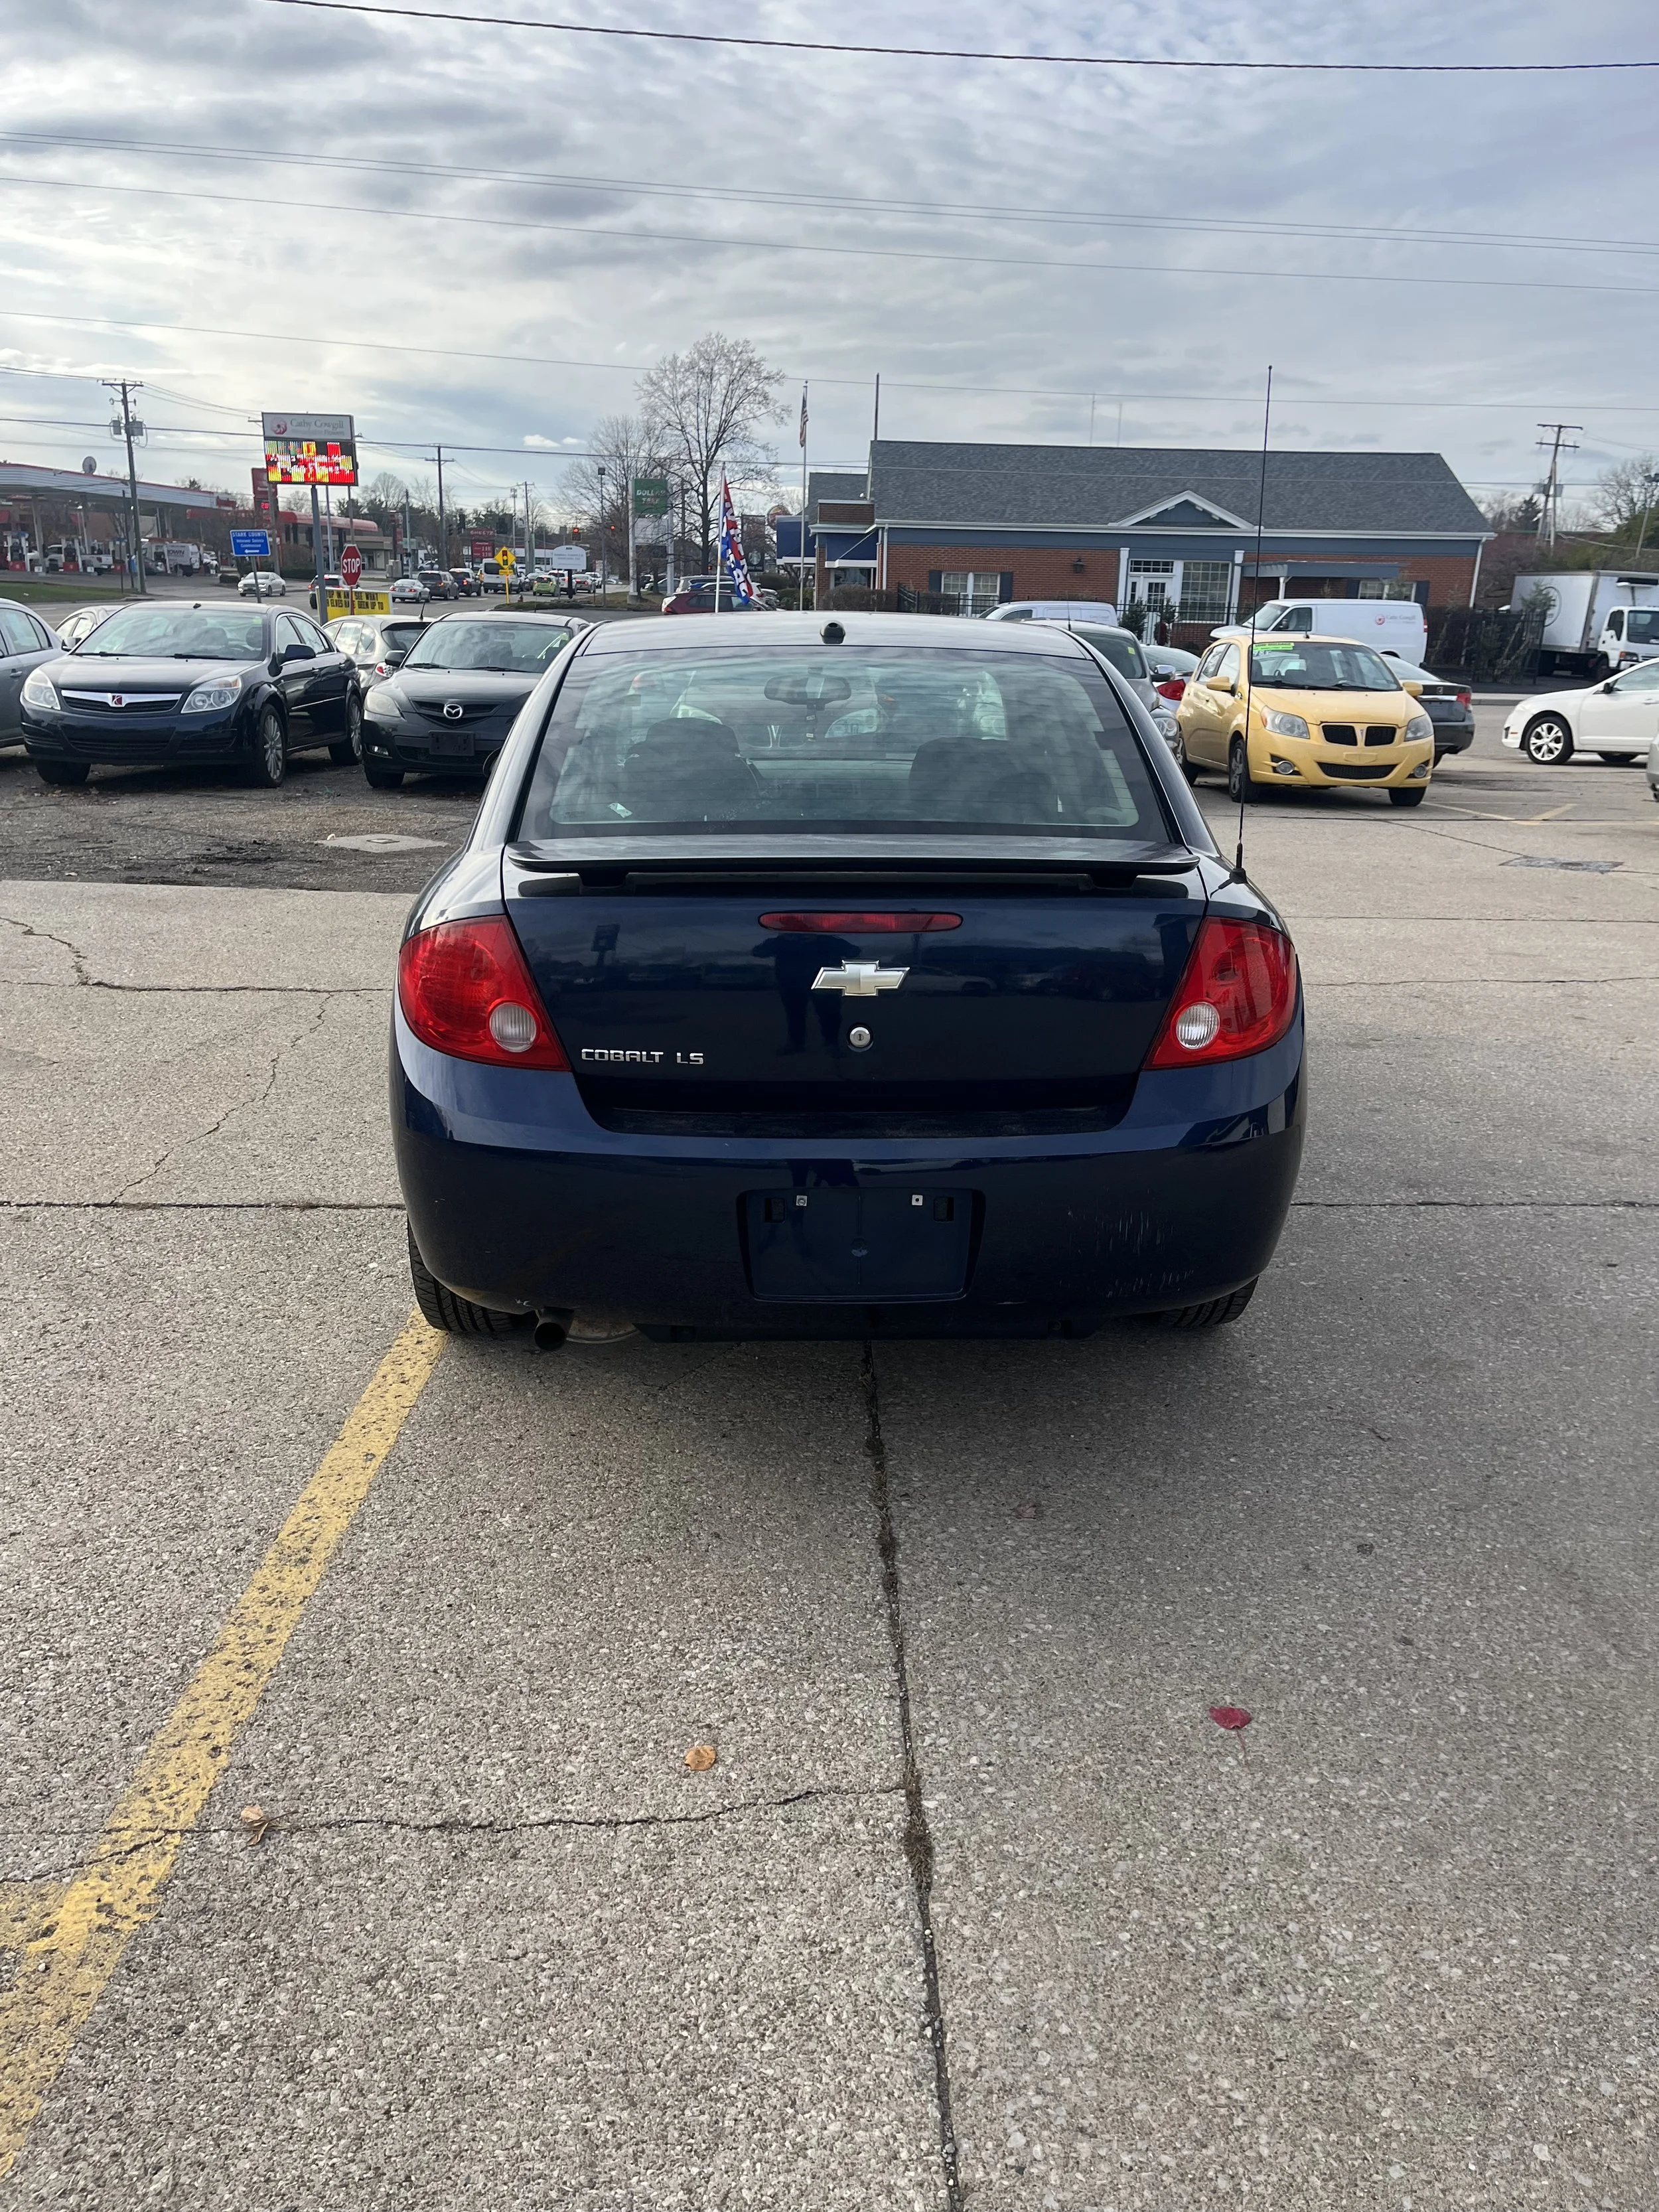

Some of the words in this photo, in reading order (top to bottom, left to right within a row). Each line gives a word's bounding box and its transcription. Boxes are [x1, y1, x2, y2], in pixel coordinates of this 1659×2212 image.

[290, 418, 312, 430] Cathy
[314, 419, 344, 431] Cowgill
[342, 558, 360, 573] STOP
[330, 599, 343, 608] ELVES
[358, 600, 370, 609] BEEN
[370, 601, 376, 610] UP
[378, 602, 384, 611] TO
[581, 1048, 664, 1063] COBALT
[676, 1052, 704, 1065] LS
